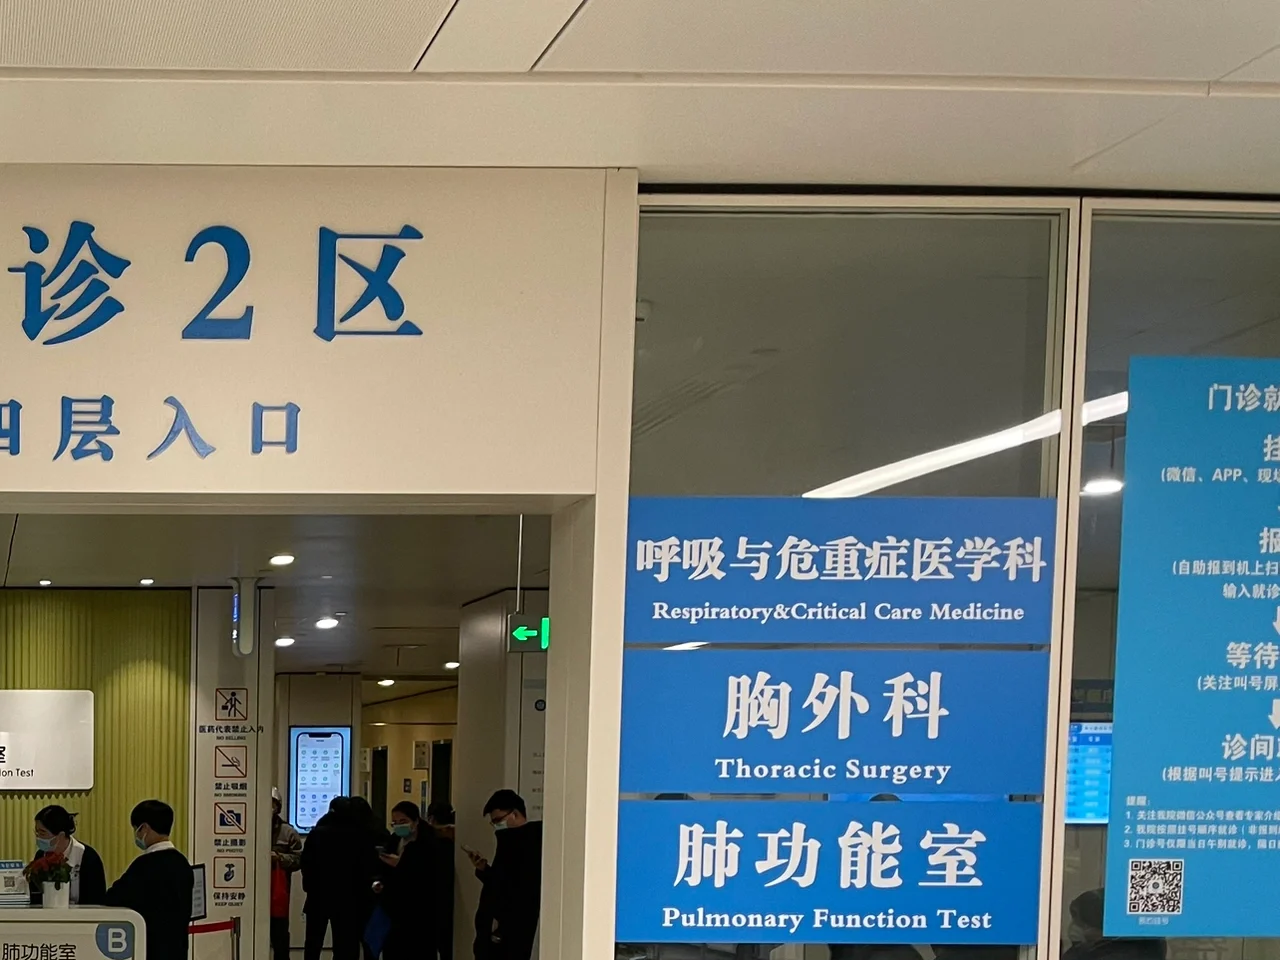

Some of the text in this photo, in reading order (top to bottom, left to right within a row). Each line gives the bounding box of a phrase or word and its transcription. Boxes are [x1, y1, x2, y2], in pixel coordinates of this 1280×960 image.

[636, 535, 1047, 583] 呼吸与危重症医学科
[652, 602, 1025, 624] Respiratory&Critical Care Medicine
[1226, 642, 1279, 669] 等待
[723, 671, 949, 740] 胸外科
[1221, 733, 1280, 761] 诊间
[15, 767, 34, 777] Test
[714, 758, 952, 785] Thoracic Surgery
[674, 820, 986, 889] 肺功能室
[662, 908, 992, 934] Pulmonary Function Test
[107, 928, 127, 953] B
